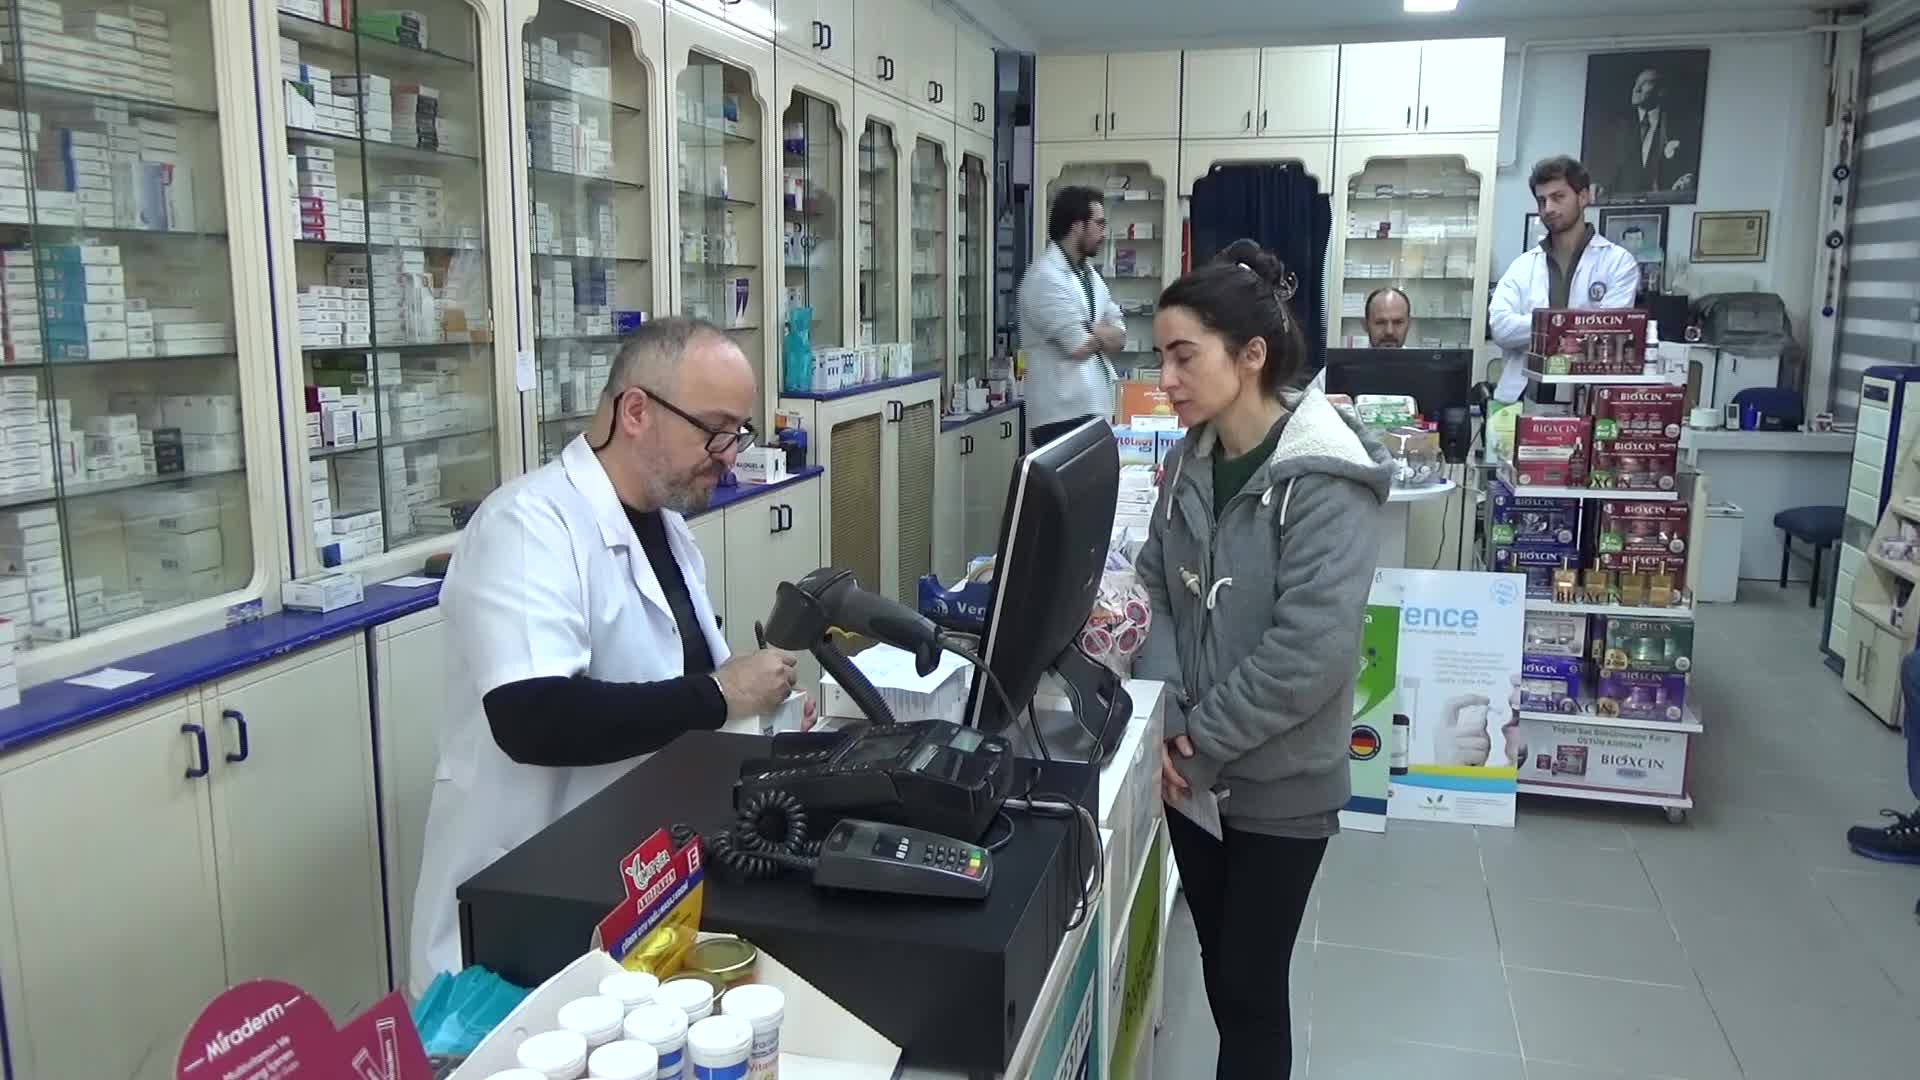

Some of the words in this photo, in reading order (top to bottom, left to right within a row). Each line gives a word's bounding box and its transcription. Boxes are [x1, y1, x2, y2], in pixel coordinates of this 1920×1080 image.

[1574, 314, 1624, 325] BIOXCIN
[1620, 392, 1662, 401] BIOXCIN
[1533, 423, 1577, 433] BIOXCIN
[1113, 436, 1152, 447] YLOLHOT
[1159, 436, 1176, 447] TYL
[1614, 442, 1656, 450] BIOXCIN
[1514, 497, 1554, 506] BIOXCIN
[1624, 504, 1667, 514] BIOXCIN
[1556, 590, 1624, 605] BIOXCIN
[956, 600, 987, 615] Ven
[1522, 662, 1558, 674] IOXCIN
[1545, 696, 1612, 714] BIOXCIN
[1600, 753, 1665, 769] BIOXCIN
[206, 1002, 285, 1063] Miraderm
